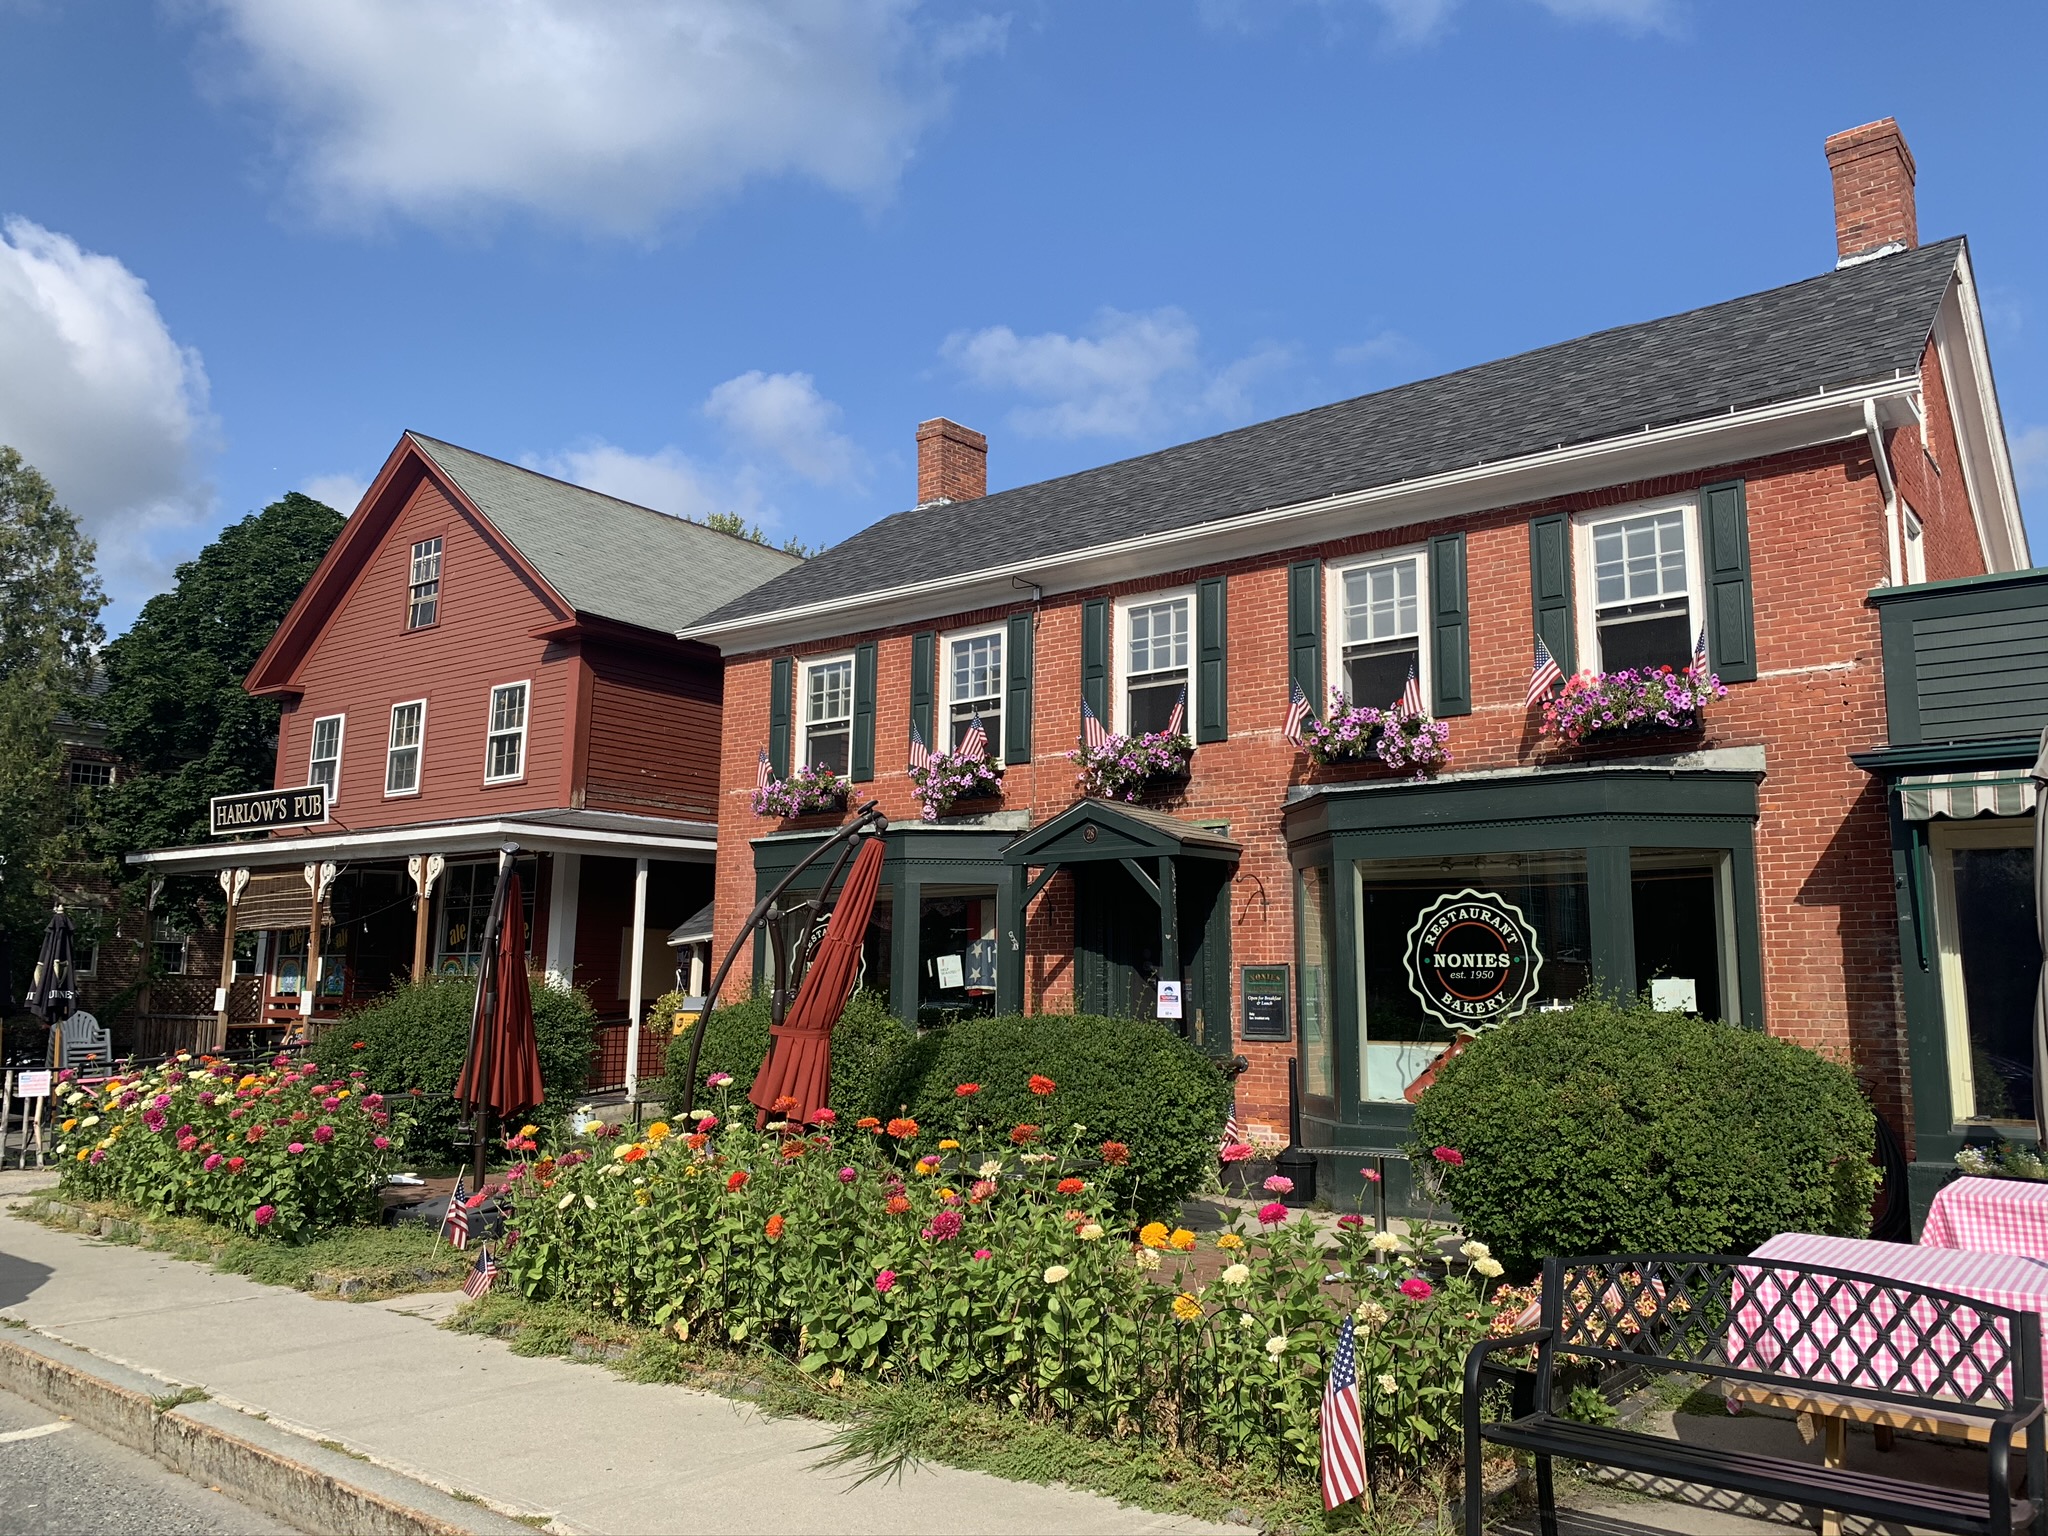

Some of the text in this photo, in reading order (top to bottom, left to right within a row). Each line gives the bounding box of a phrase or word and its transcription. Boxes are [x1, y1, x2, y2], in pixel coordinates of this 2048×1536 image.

[216, 795, 322, 825] HARLOW'S PUB
[1086, 828, 1095, 839] 28
[450, 923, 466, 946] ale
[1425, 908, 1518, 946] RESTAURANT
[288, 929, 303, 951] ale
[1433, 953, 1511, 968] NONIES
[1249, 973, 1281, 981] NONIES
[1450, 970, 1494, 979] est. 1950
[1441, 991, 1507, 1014] BAKERY
